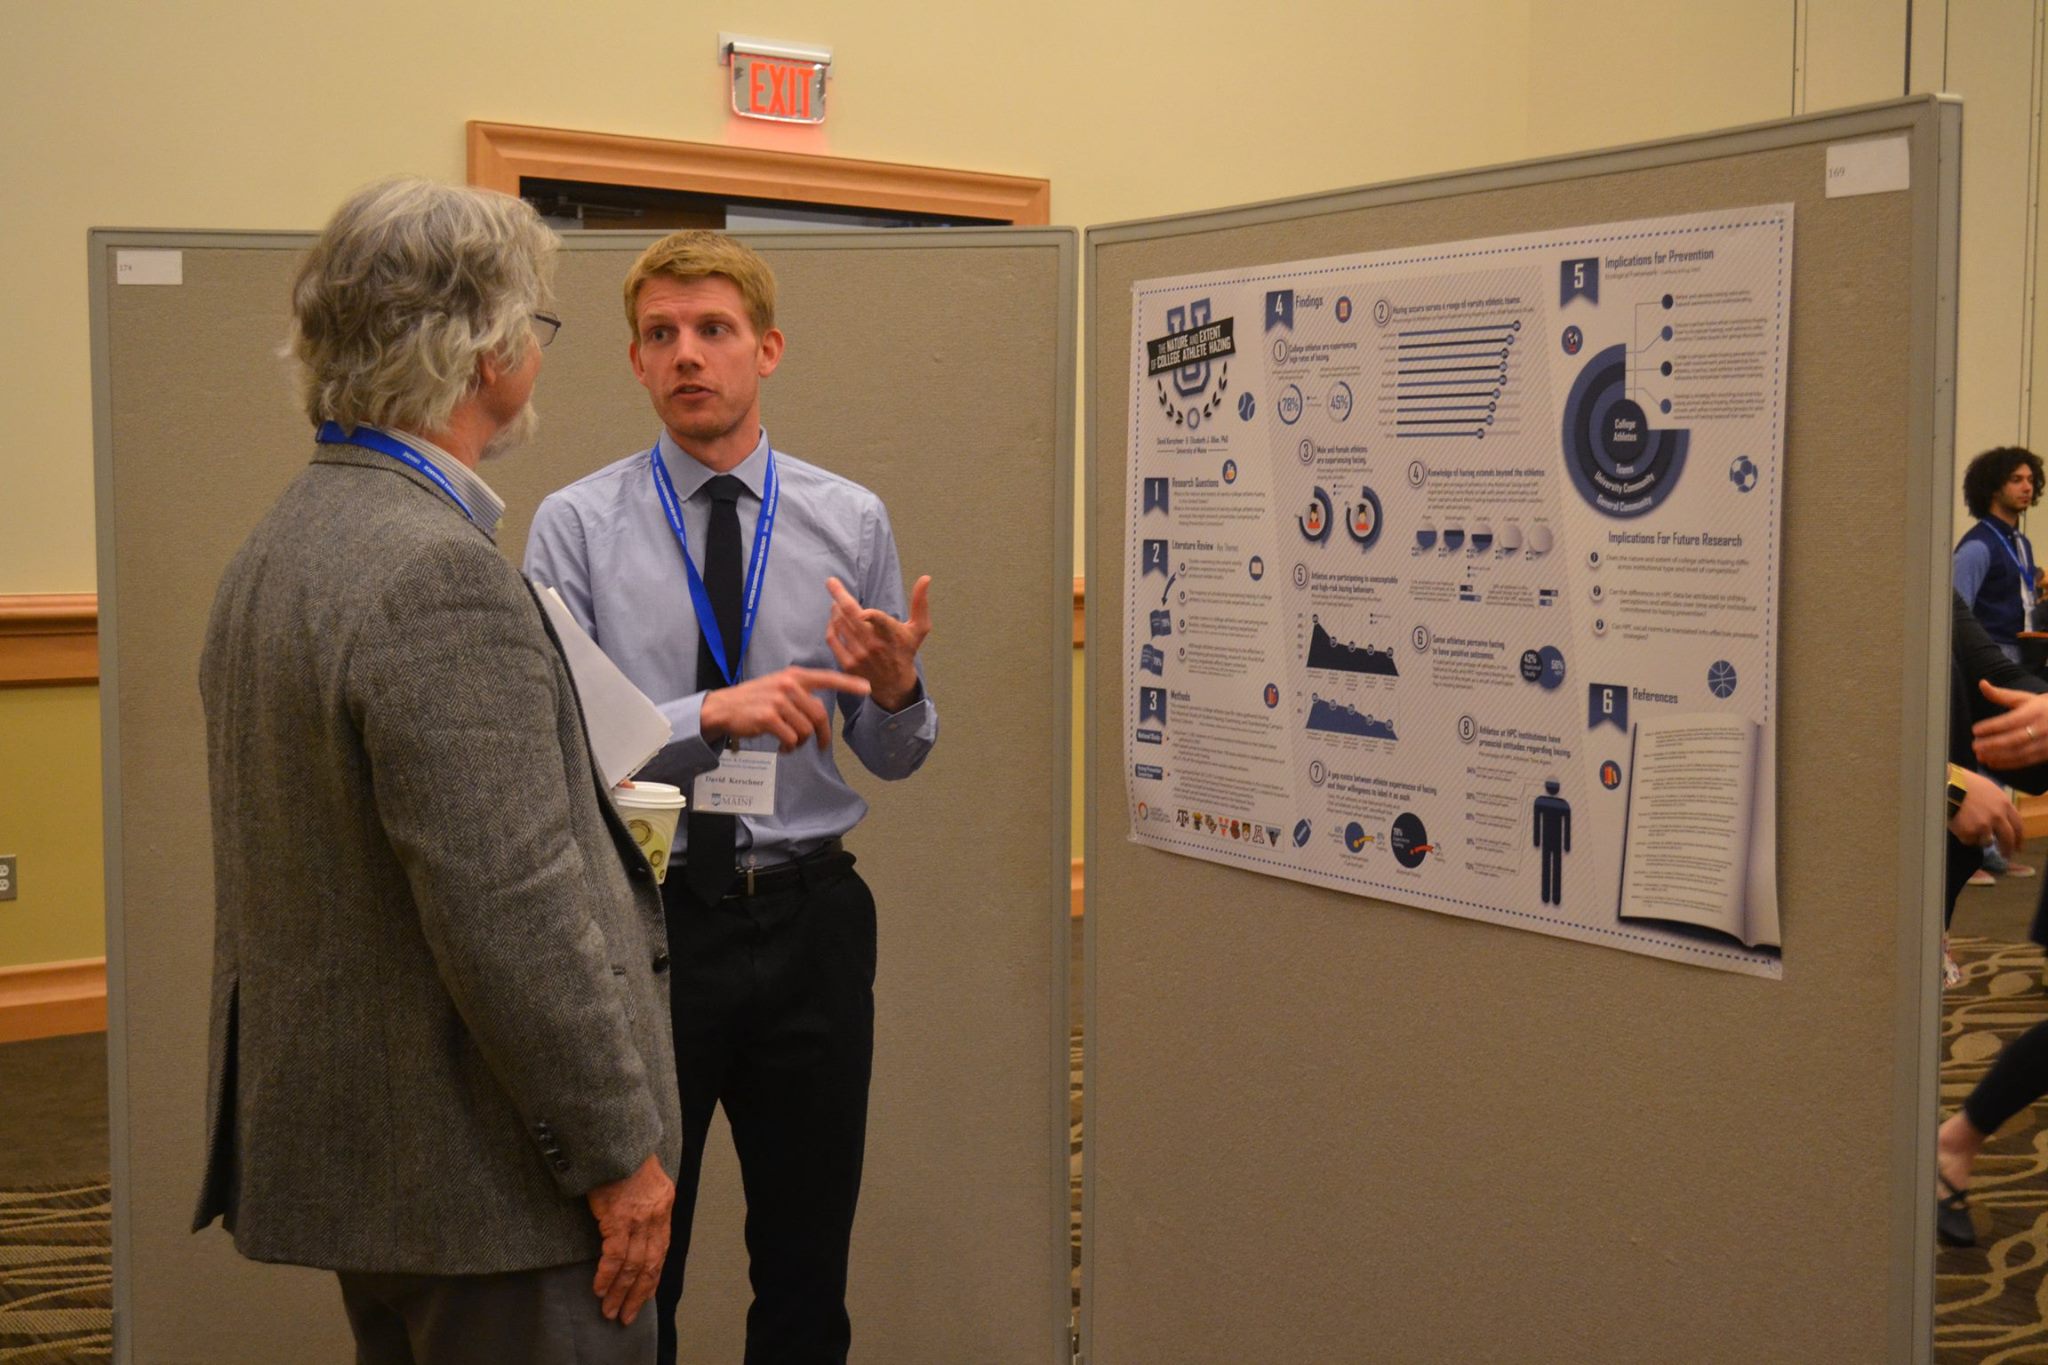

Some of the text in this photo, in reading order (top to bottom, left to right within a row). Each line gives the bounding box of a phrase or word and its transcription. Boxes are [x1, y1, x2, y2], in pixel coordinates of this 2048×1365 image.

[750, 61, 816, 118] EXIT
[1828, 167, 1845, 178] 169
[1605, 249, 1714, 270] Implications for Prevention
[1574, 262, 1584, 288] 5
[1275, 294, 1283, 316] 4
[1296, 295, 1323, 309] Findings
[1167, 334, 1189, 352] NATURE
[1199, 325, 1221, 343] EXTENT
[1151, 336, 1232, 370] OF COLLEGE ATHLETE HAZING
[1282, 396, 1299, 412] 78%
[1614, 418, 1636, 430] College
[1613, 432, 1637, 442] Athletes
[1615, 464, 1634, 475] Teams
[1154, 480, 1159, 501] 1
[1172, 477, 1219, 488] Research Questions
[1594, 470, 1623, 495] University
[1596, 493, 1619, 511] General
[1172, 540, 1196, 550] Literature
[1197, 540, 1213, 551] Review
[1609, 531, 1742, 547] Implications For Future Research
[1153, 543, 1160, 563] 2
[1150, 690, 1157, 710] 3
[1170, 690, 1191, 701] Methods
[1603, 688, 1613, 714] 6
[1633, 688, 1678, 704] References
[729, 777, 764, 786] Kerschner
